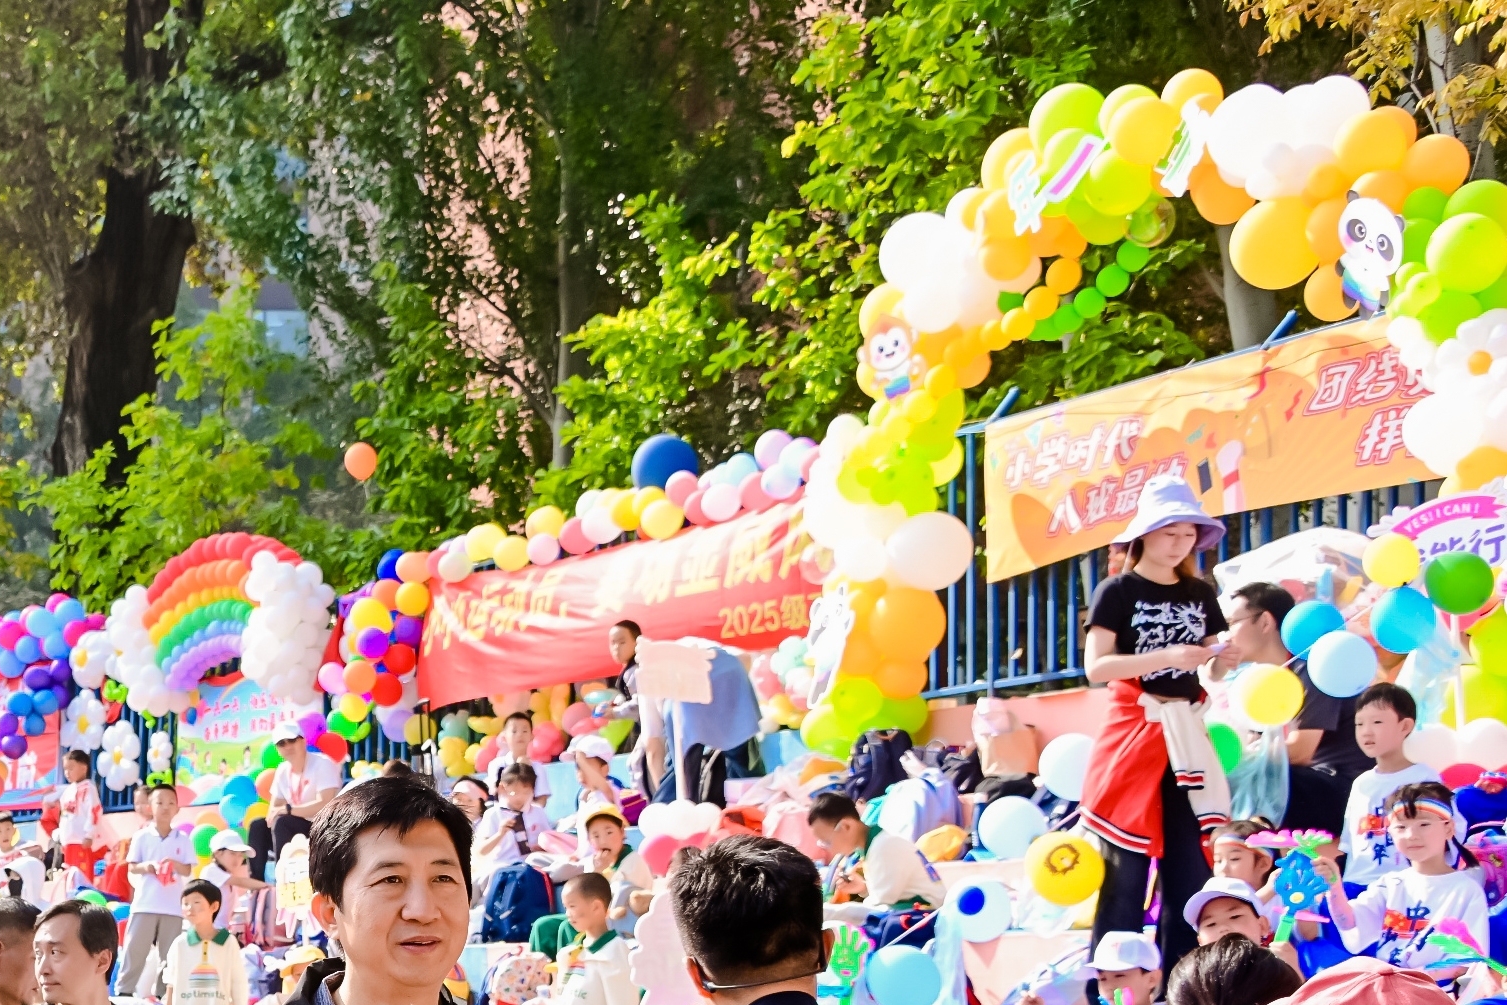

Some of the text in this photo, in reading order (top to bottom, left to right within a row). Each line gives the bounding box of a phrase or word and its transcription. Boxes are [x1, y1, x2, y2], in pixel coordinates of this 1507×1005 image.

[1004, 417, 1143, 492] 小学时代
[718, 592, 821, 639] 2025级
